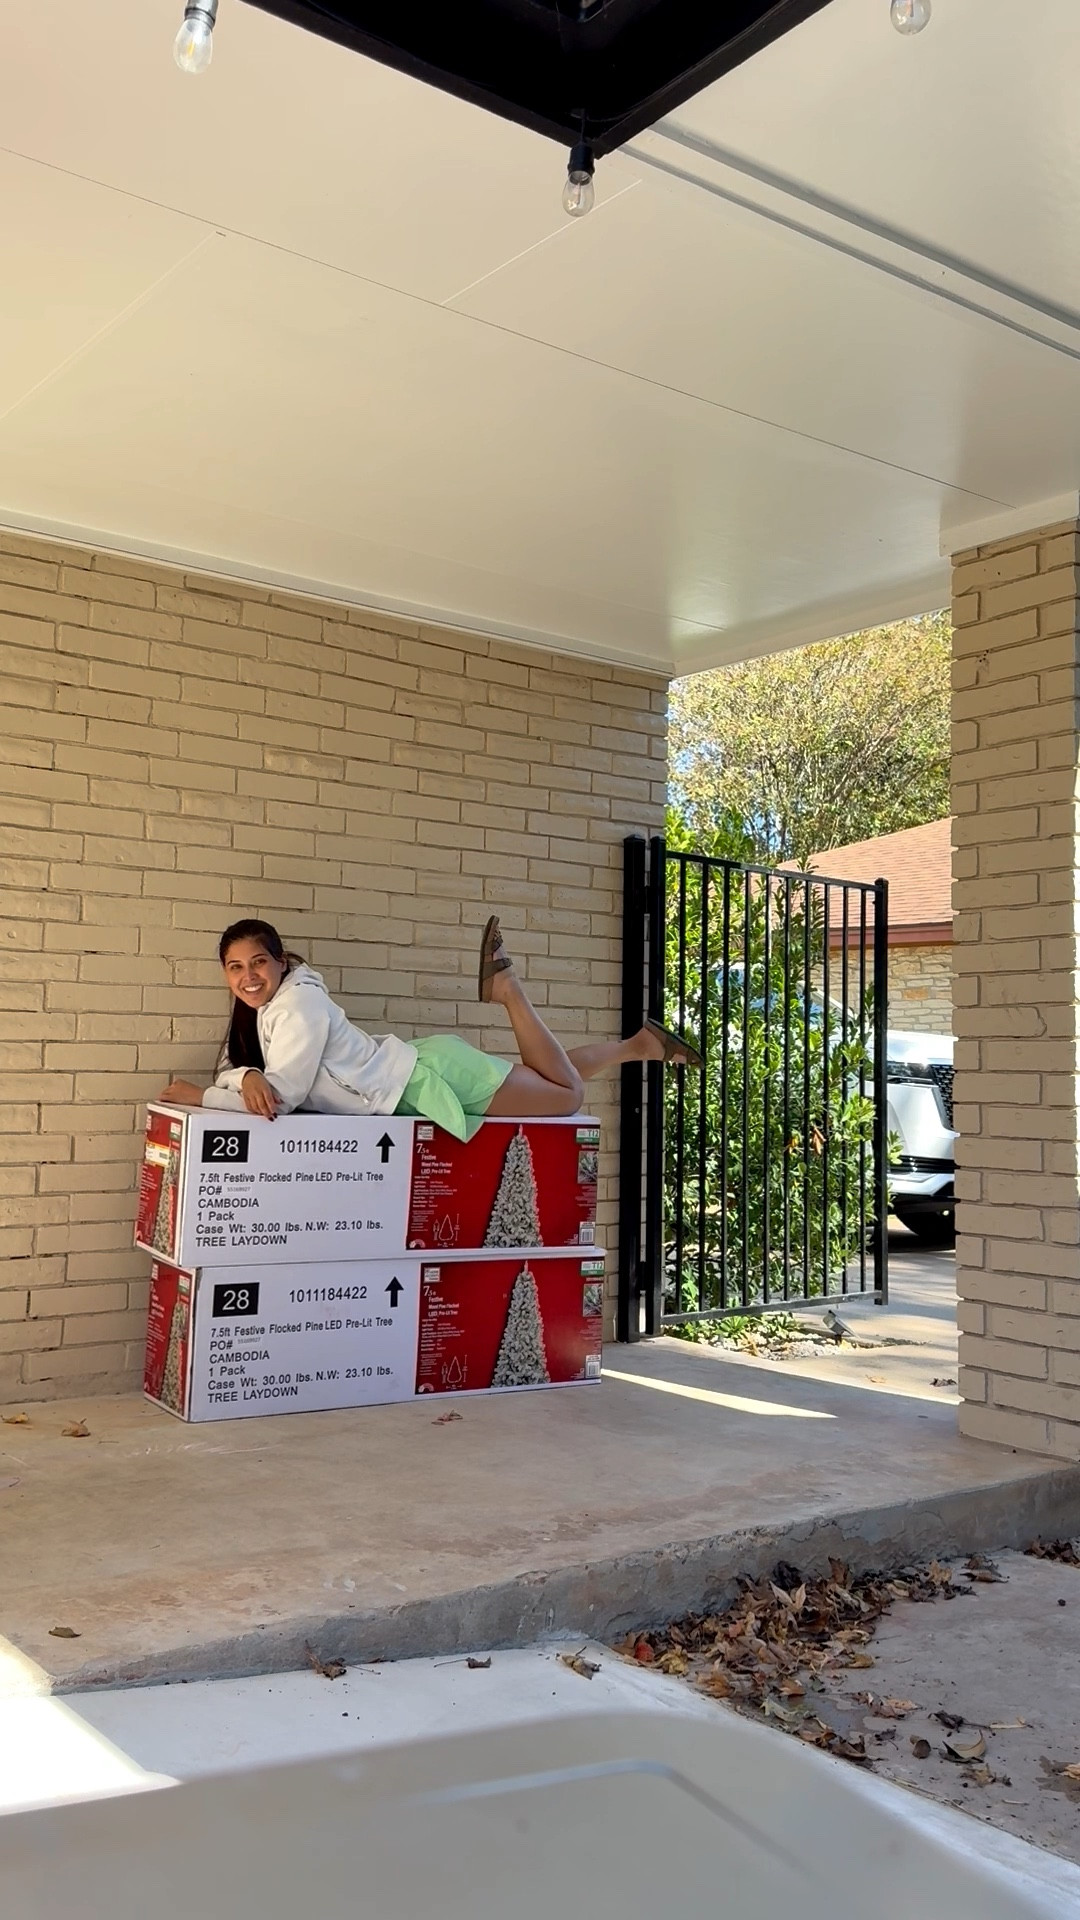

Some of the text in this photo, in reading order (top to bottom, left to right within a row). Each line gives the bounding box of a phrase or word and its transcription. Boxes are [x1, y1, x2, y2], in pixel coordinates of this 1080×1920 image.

[211, 1136, 240, 1157] 28
[280, 1140, 359, 1153] 1011184422
[200, 1172, 384, 1183] 7.5ft Festive Flocked Pine LED Pre-Lit Tree
[199, 1186, 222, 1195] PO#
[198, 1198, 259, 1209] CAMBODIA
[197, 1211, 235, 1221] 1 Pack
[196, 1220, 383, 1235] Case Wt: 30.00 lbs. N.W: 23.10 lbs.
[195, 1235, 287, 1247] TREE LAYDOWN
[222, 1290, 250, 1311] 28
[289, 1286, 368, 1303] 1011184422
[211, 1316, 393, 1338] 7.5ft Festive Flocked Pine LED Pre-Lit Tree
[210, 1340, 233, 1351] PO#
[209, 1350, 270, 1363] CAMBODIA
[208, 1365, 246, 1377] 1 Pack
[208, 1366, 394, 1391] Case Wt: 30.00 lbs. N.W: 23.10 lbs.
[208, 1386, 298, 1403] TREE LAYDOWN
